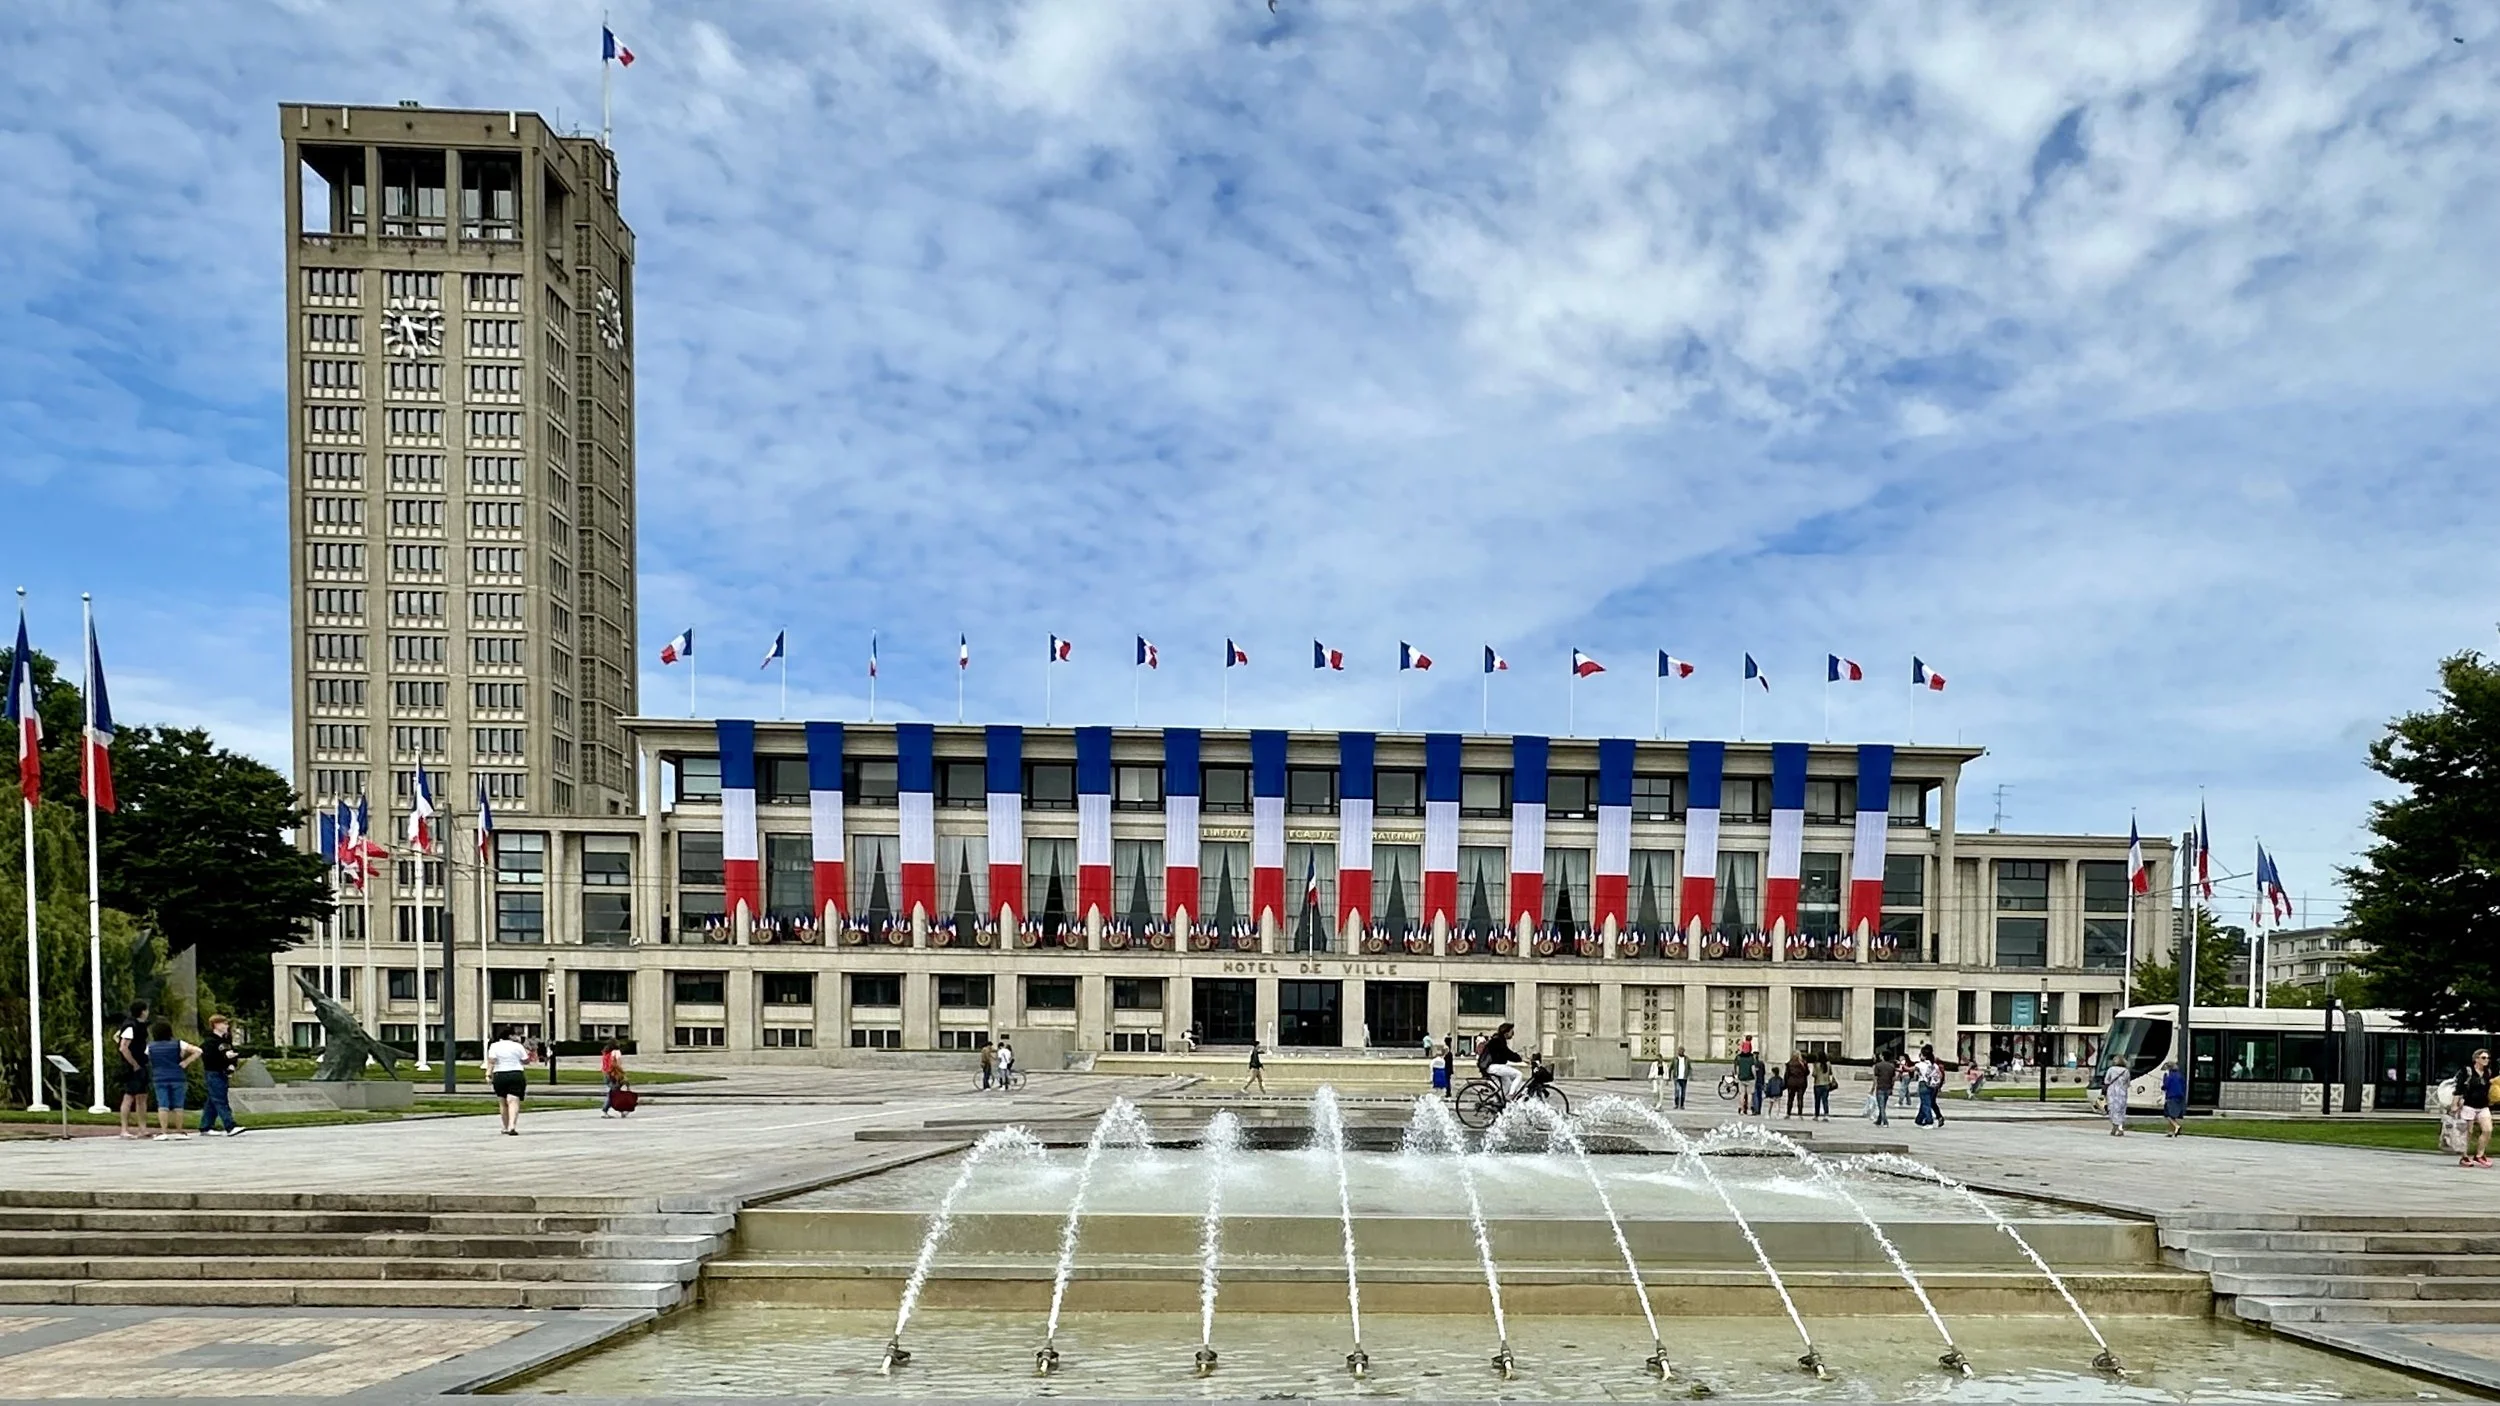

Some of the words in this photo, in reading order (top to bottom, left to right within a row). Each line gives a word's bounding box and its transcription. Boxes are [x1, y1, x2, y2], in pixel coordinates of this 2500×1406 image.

[1223, 962, 1279, 974] HOTEL
[1299, 963, 1322, 974] DE
[1342, 963, 1397, 975] VILLE
